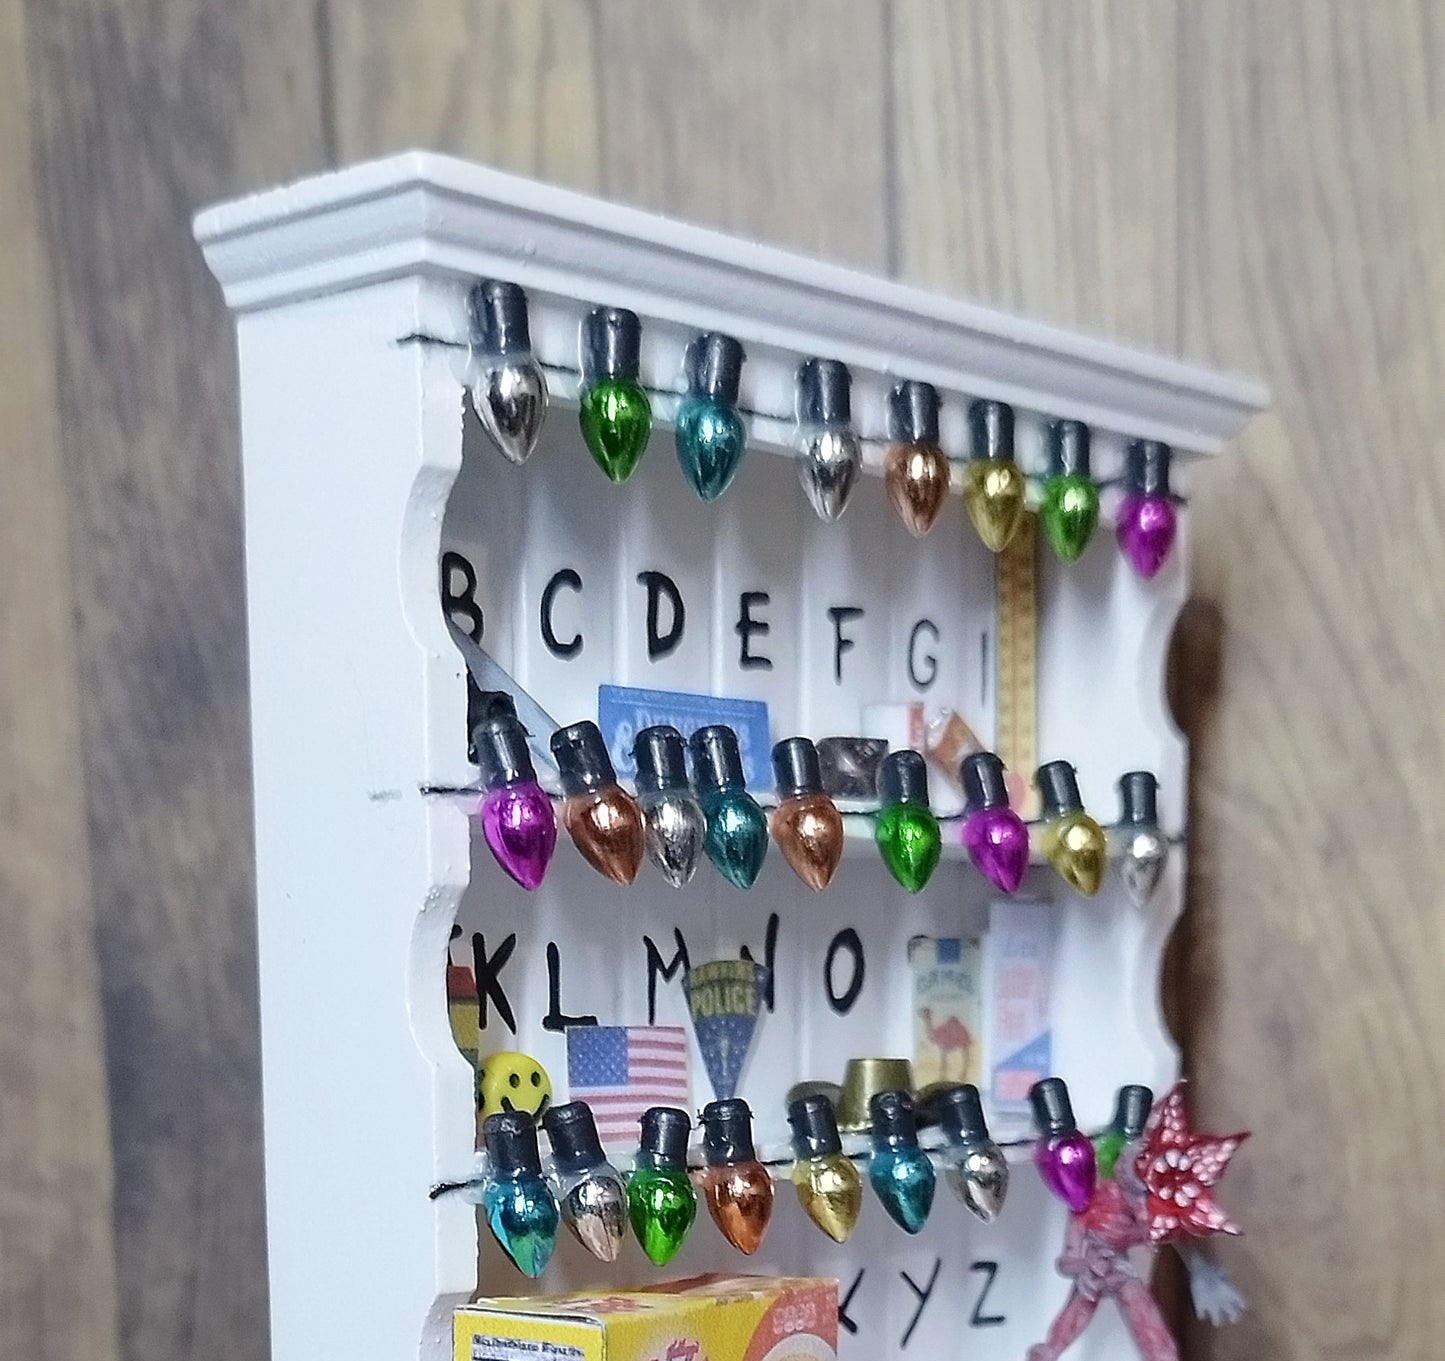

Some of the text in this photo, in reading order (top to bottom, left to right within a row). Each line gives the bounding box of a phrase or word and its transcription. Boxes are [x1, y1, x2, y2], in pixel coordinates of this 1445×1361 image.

[441, 551, 484, 646] B
[540, 568, 583, 662] C
[636, 571, 686, 664] D
[734, 591, 773, 672] E
[827, 607, 865, 687] F
[907, 618, 941, 694] G
[471, 931, 517, 1036] K
[541, 941, 599, 1034] L
[643, 926, 692, 1026] M
[824, 927, 866, 1017] O
[690, 980, 758, 1018] POLICE
[899, 1257, 943, 1350] Y
[969, 1260, 1007, 1329] Z
